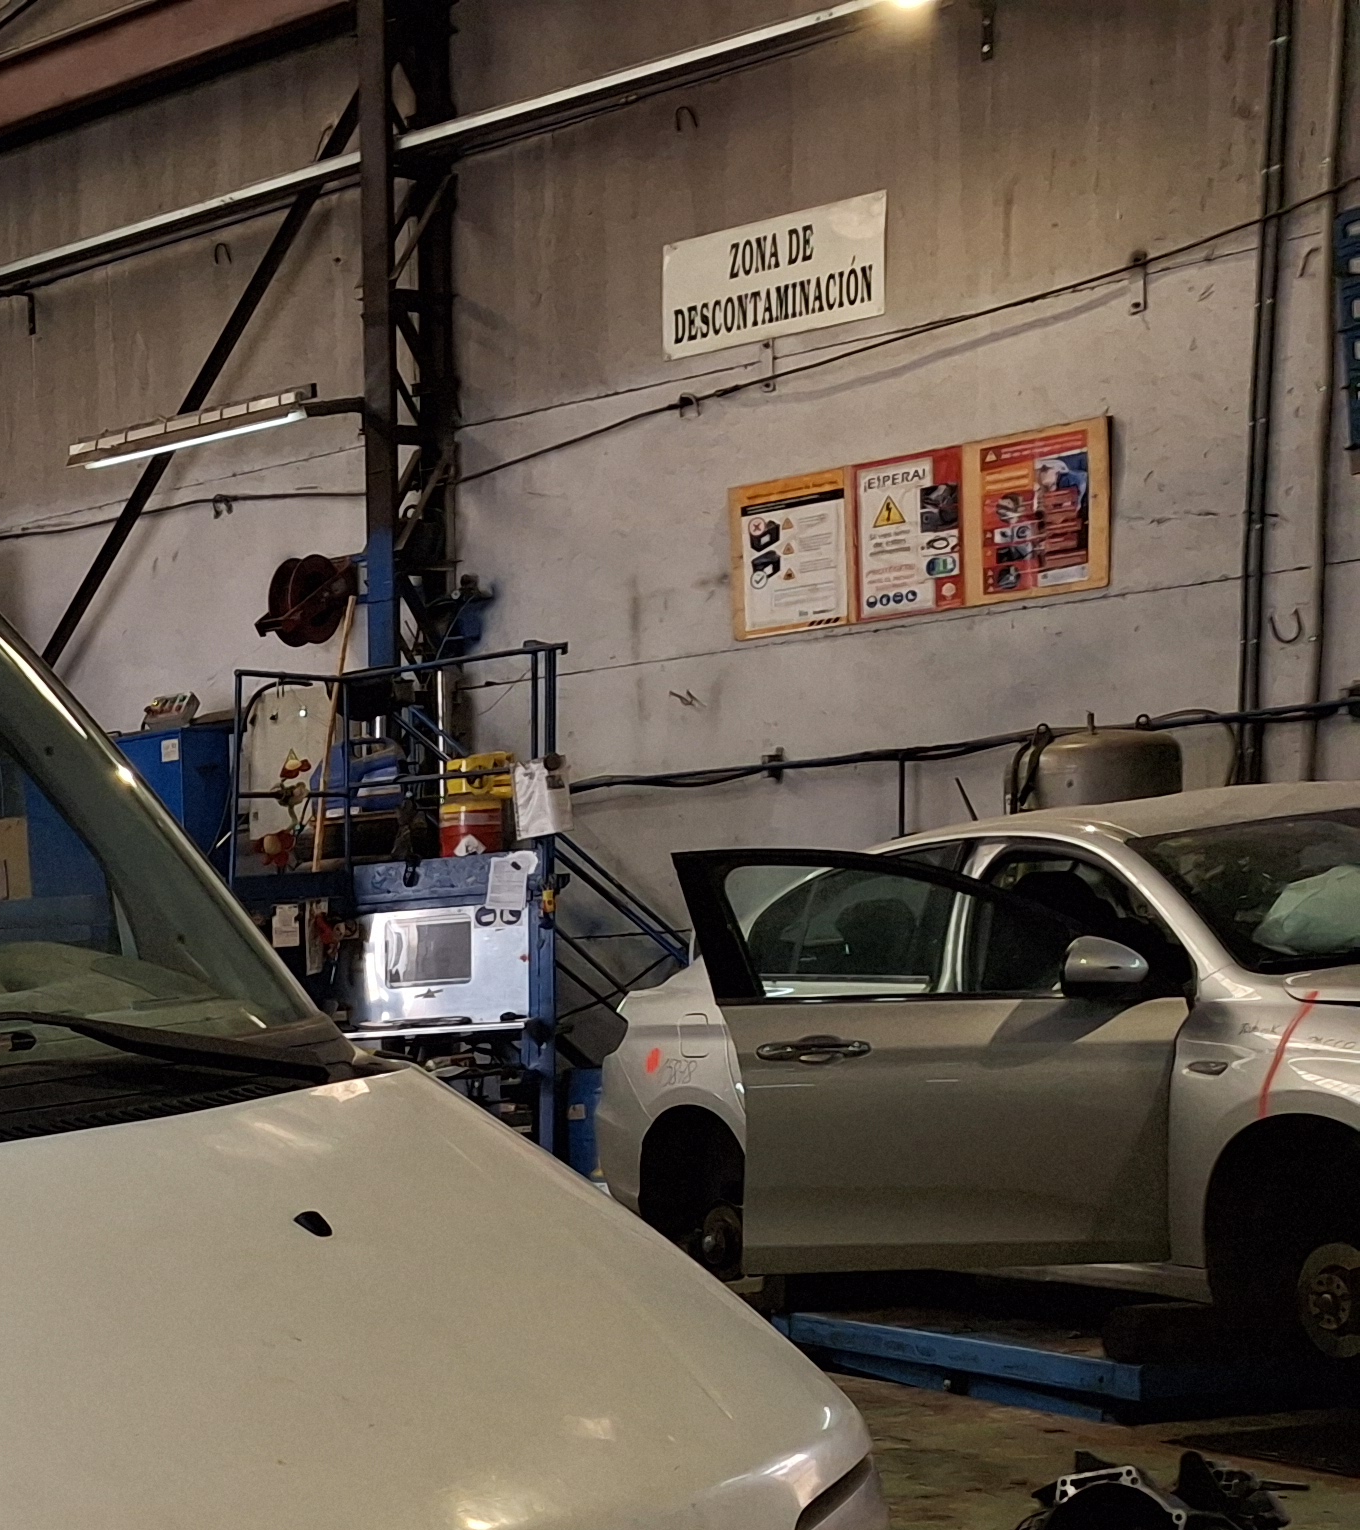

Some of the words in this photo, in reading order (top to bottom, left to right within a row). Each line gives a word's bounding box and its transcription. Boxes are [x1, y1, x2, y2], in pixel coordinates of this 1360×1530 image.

[729, 233, 780, 280] ZONA
[787, 224, 815, 266] DE
[673, 255, 874, 345] DESCONTAMINACIÓN
